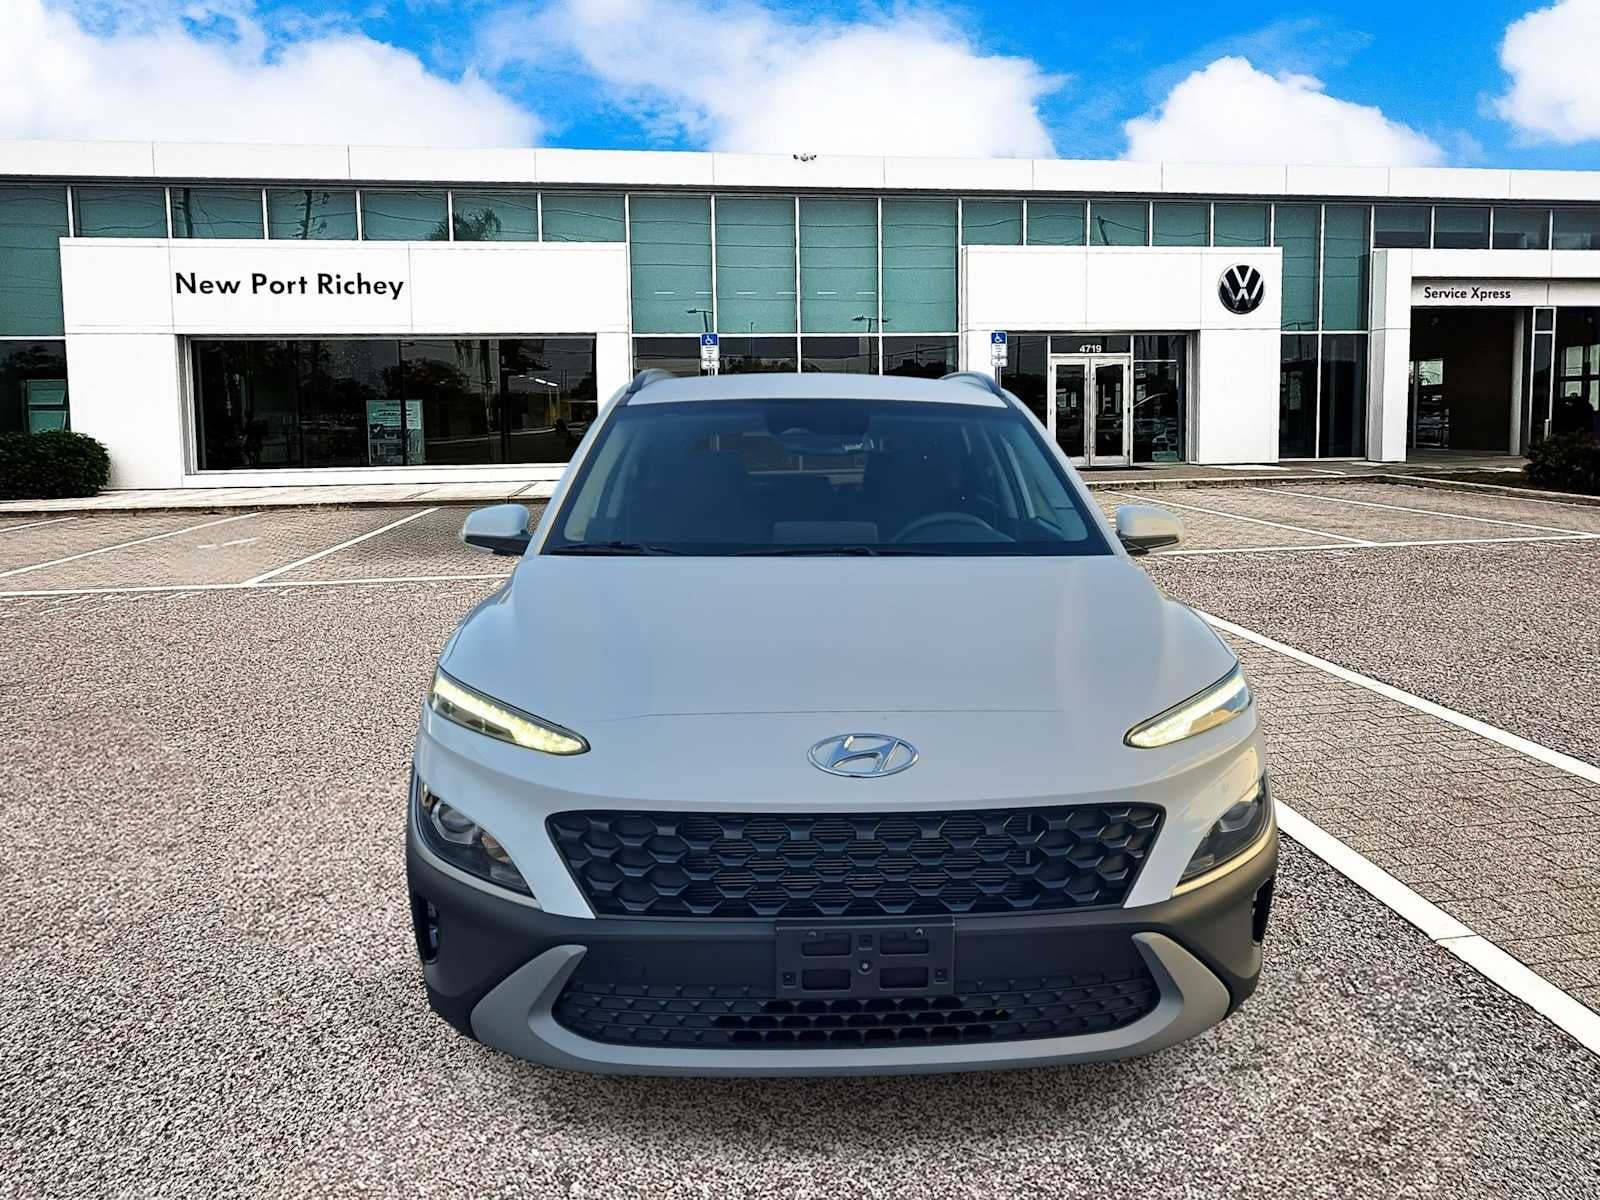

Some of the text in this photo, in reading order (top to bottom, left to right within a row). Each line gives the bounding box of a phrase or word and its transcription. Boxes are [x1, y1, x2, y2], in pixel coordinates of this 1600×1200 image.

[175, 272, 404, 300] New Port Richey
[1219, 264, 1265, 313] VW
[1424, 286, 1511, 301] Service Xpress
[1080, 344, 1102, 353] 4719
